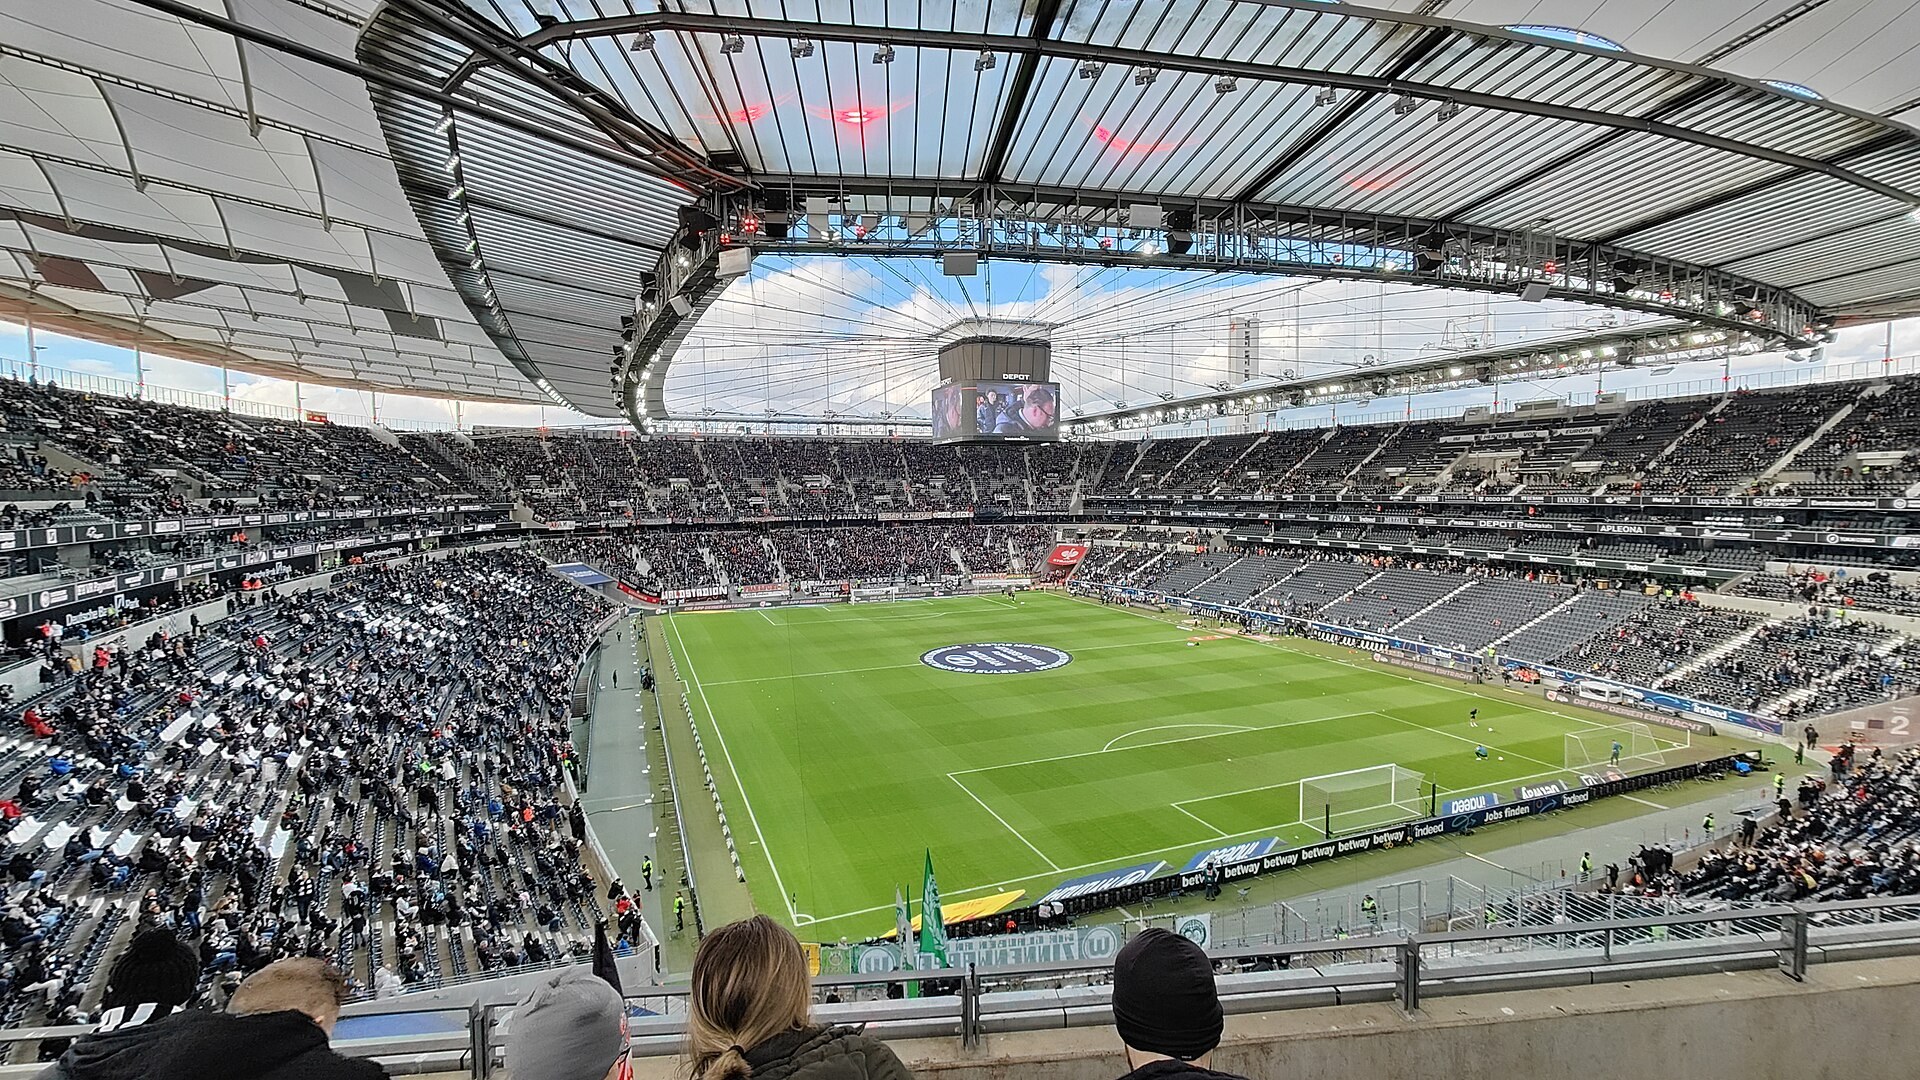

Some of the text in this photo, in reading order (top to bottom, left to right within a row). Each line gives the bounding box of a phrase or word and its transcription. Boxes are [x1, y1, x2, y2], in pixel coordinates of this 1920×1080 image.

[1565, 427, 1593, 435] EUROPA
[1600, 525, 1644, 534] APLEONA
[66, 609, 98, 626] Deutsche
[125, 597, 140, 609] Park
[1588, 701, 1608, 711] APP
[1643, 713, 1704, 731] EINTRACHT
[1691, 703, 1728, 719] indeed
[1890, 715, 1910, 735] 2
[1562, 791, 1589, 805] indeed
[1483, 805, 1530, 822] Jobs finden
[1414, 821, 1444, 838] indeed
[1182, 830, 1405, 888] betwy betway betway betway betway betway
